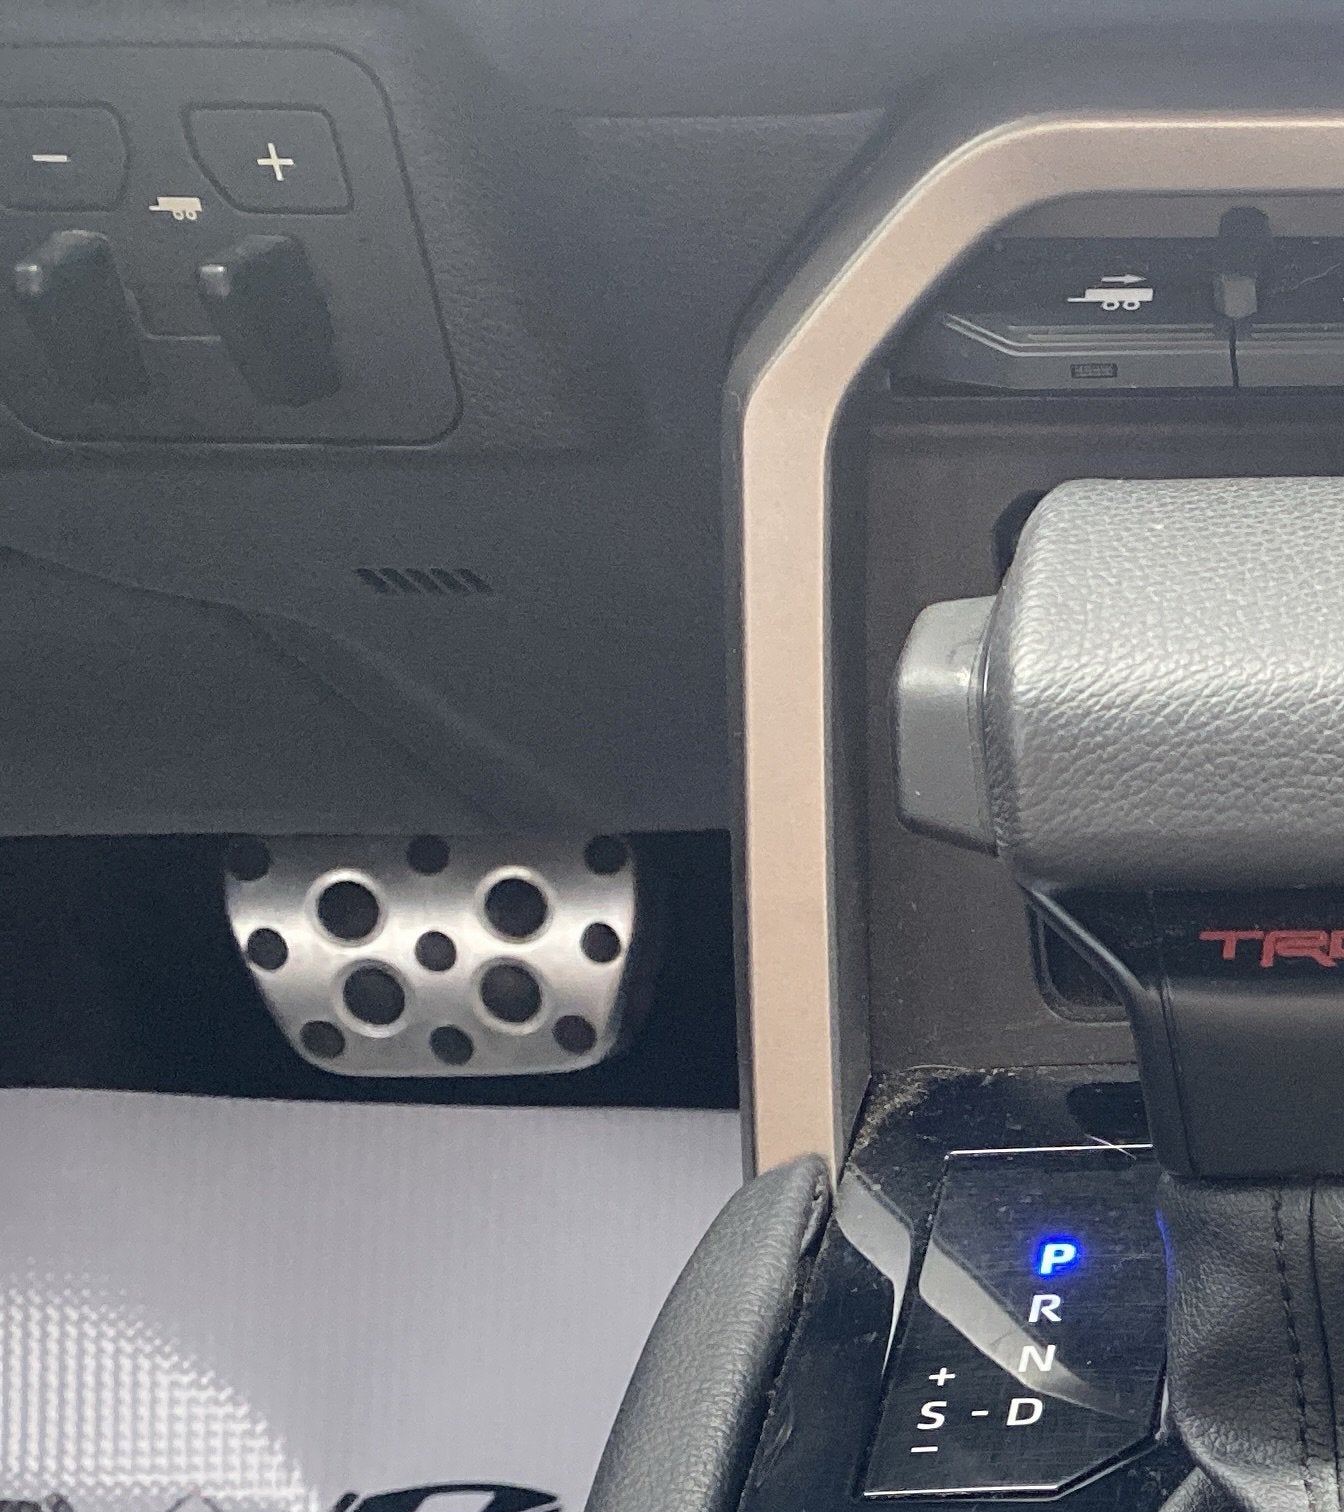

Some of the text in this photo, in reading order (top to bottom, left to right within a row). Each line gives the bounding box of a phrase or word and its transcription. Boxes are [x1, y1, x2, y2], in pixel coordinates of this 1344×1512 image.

[1039, 1243, 1077, 1275] P
[1028, 1294, 1062, 1323] R
[1018, 1344, 1056, 1373] N
[916, 1400, 948, 1430] S
[1006, 1397, 1043, 1427] D
